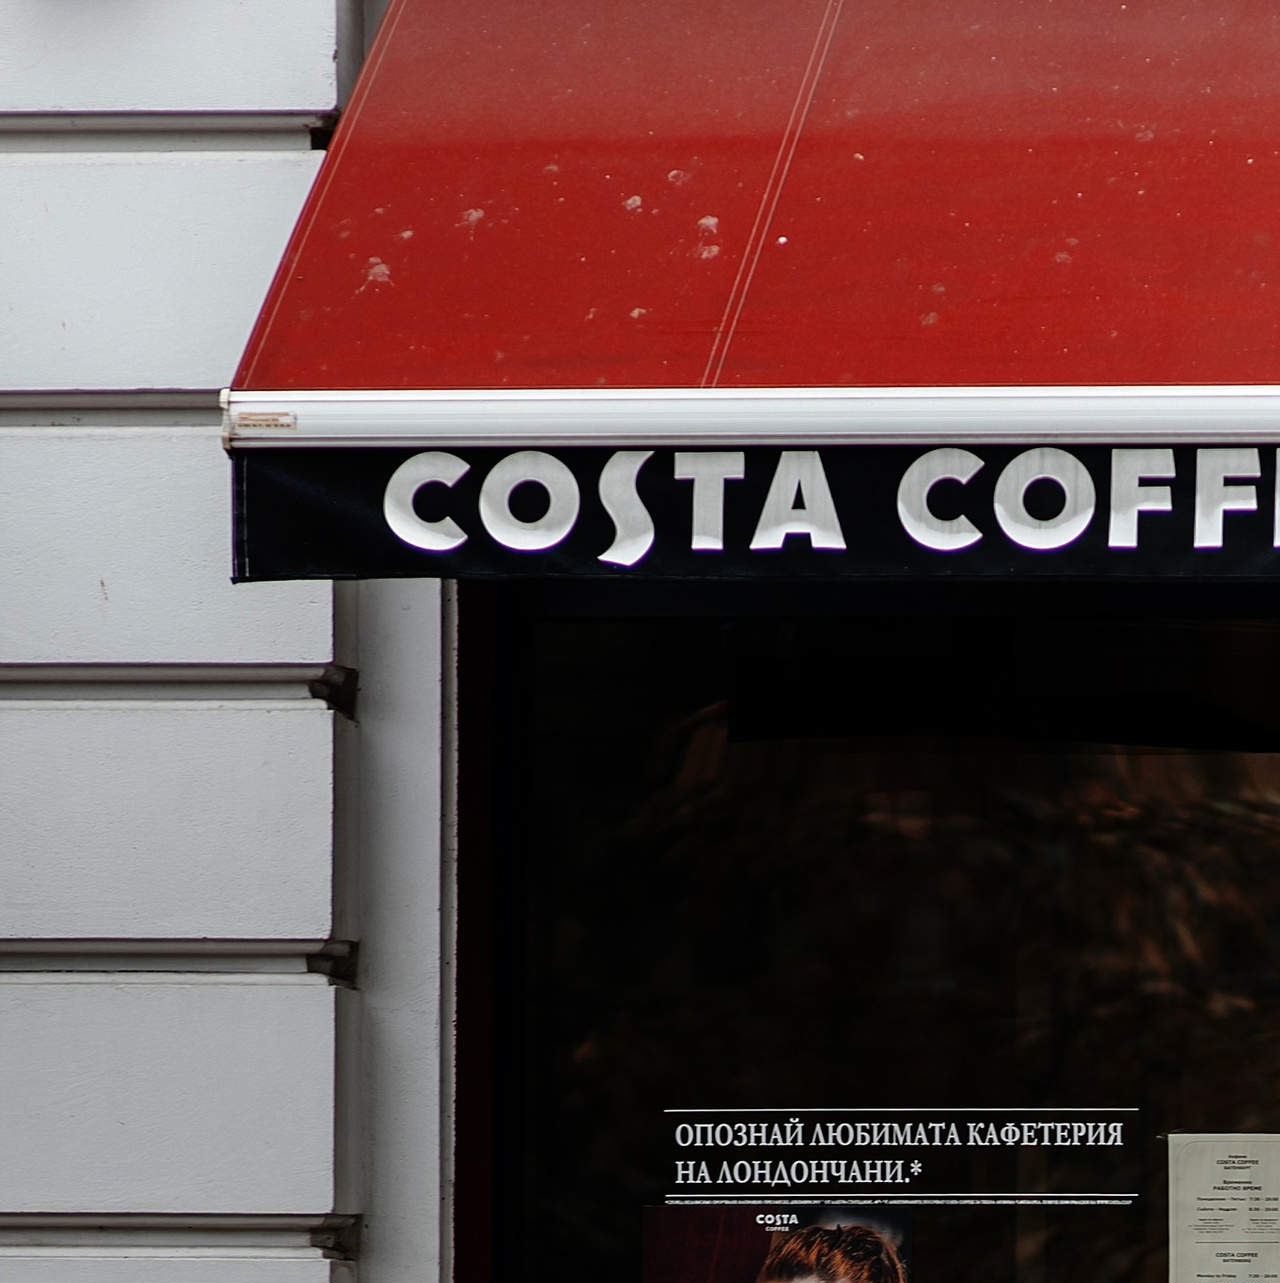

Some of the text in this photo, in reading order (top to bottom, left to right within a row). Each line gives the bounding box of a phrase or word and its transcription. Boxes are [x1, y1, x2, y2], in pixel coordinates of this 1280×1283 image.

[383, 449, 847, 567] COSTA
[675, 1118, 1123, 1146] ОПОЗНАЙ ЛЮБИМАТА КАФЕТЕРИЯ
[675, 1161, 712, 1183] НА
[755, 1214, 799, 1226] COSTA
